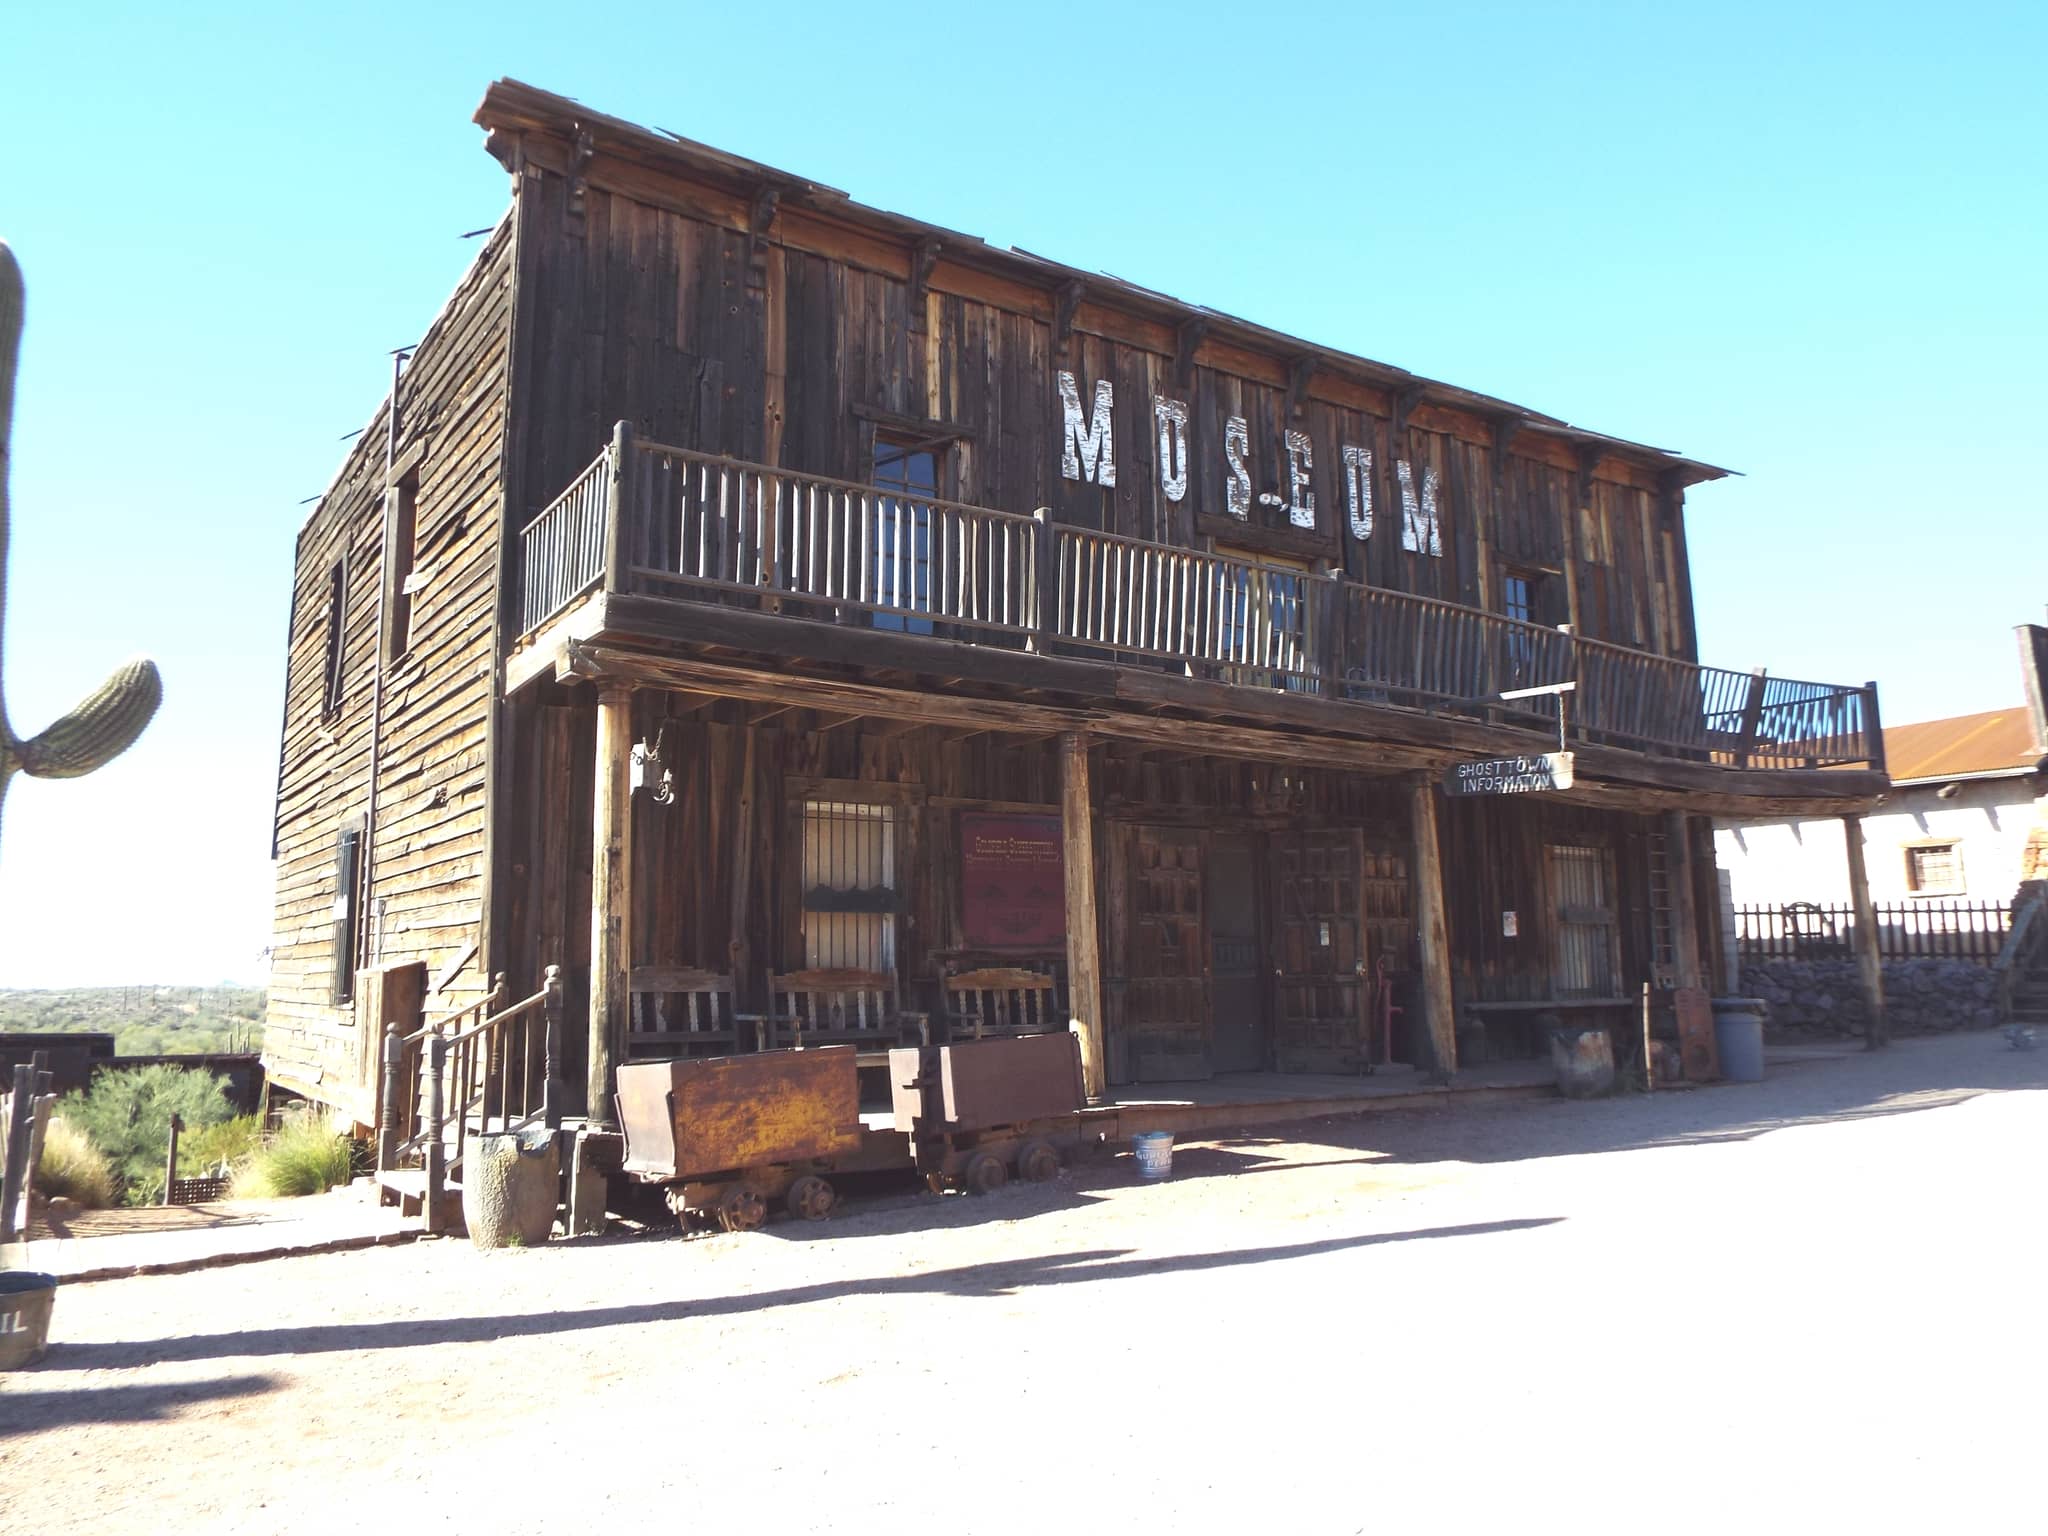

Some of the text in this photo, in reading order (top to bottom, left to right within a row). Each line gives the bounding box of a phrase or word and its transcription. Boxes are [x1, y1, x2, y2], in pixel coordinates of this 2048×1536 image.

[1058, 370, 1443, 558] MUSEUM
[1458, 757, 1552, 777] GHOST TOWN
[1463, 773, 1552, 793] INFORMATION
